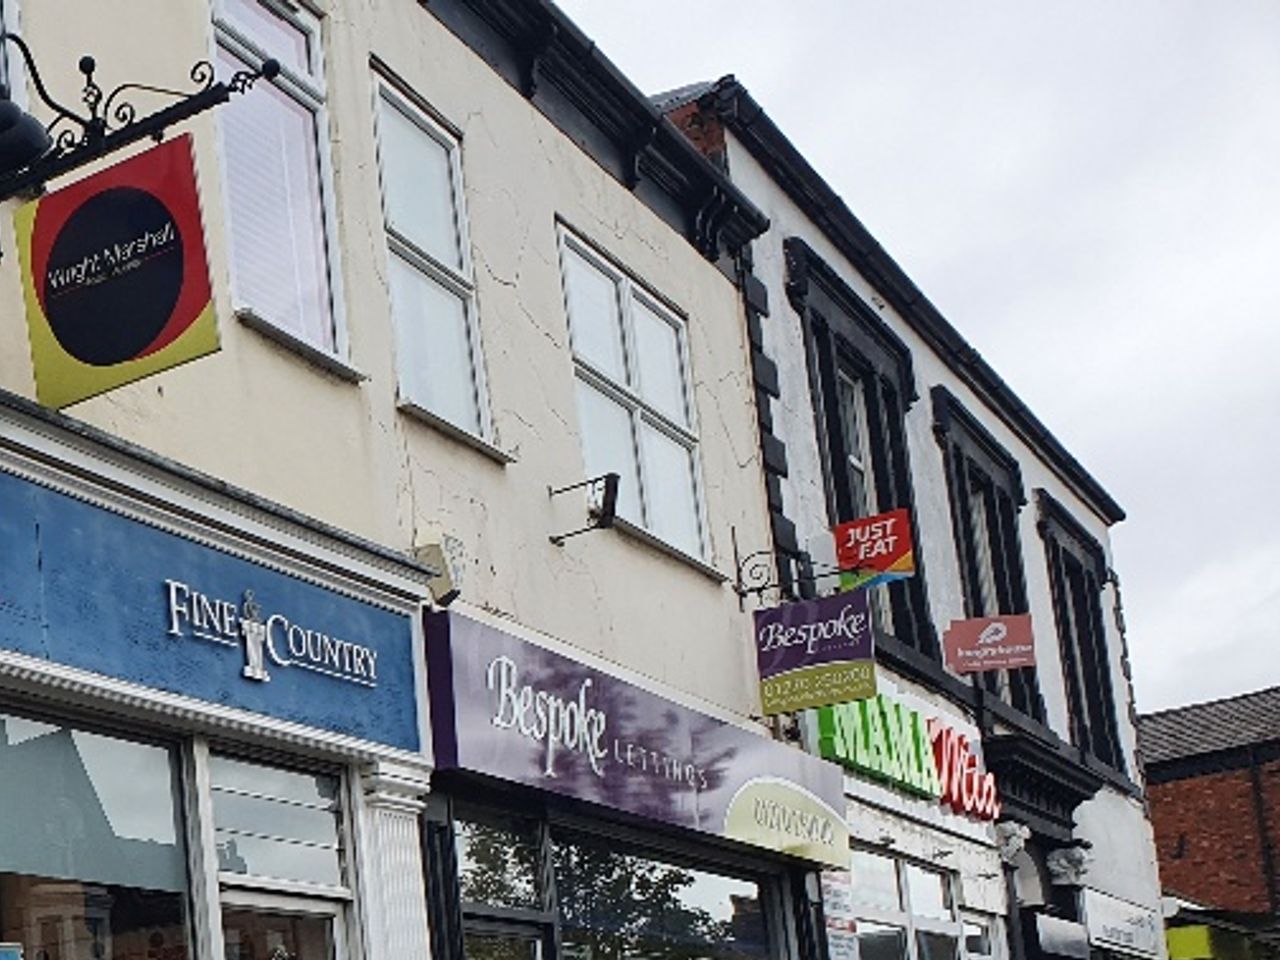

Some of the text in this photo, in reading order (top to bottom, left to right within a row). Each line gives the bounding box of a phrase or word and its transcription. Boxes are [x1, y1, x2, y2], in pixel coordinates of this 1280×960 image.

[846, 517, 898, 549] JUST
[858, 535, 899, 561] EAT
[165, 578, 378, 680] FINE COUNTRY
[759, 604, 868, 654] Bespoke
[486, 654, 709, 789] Bespoke LETTINGS
